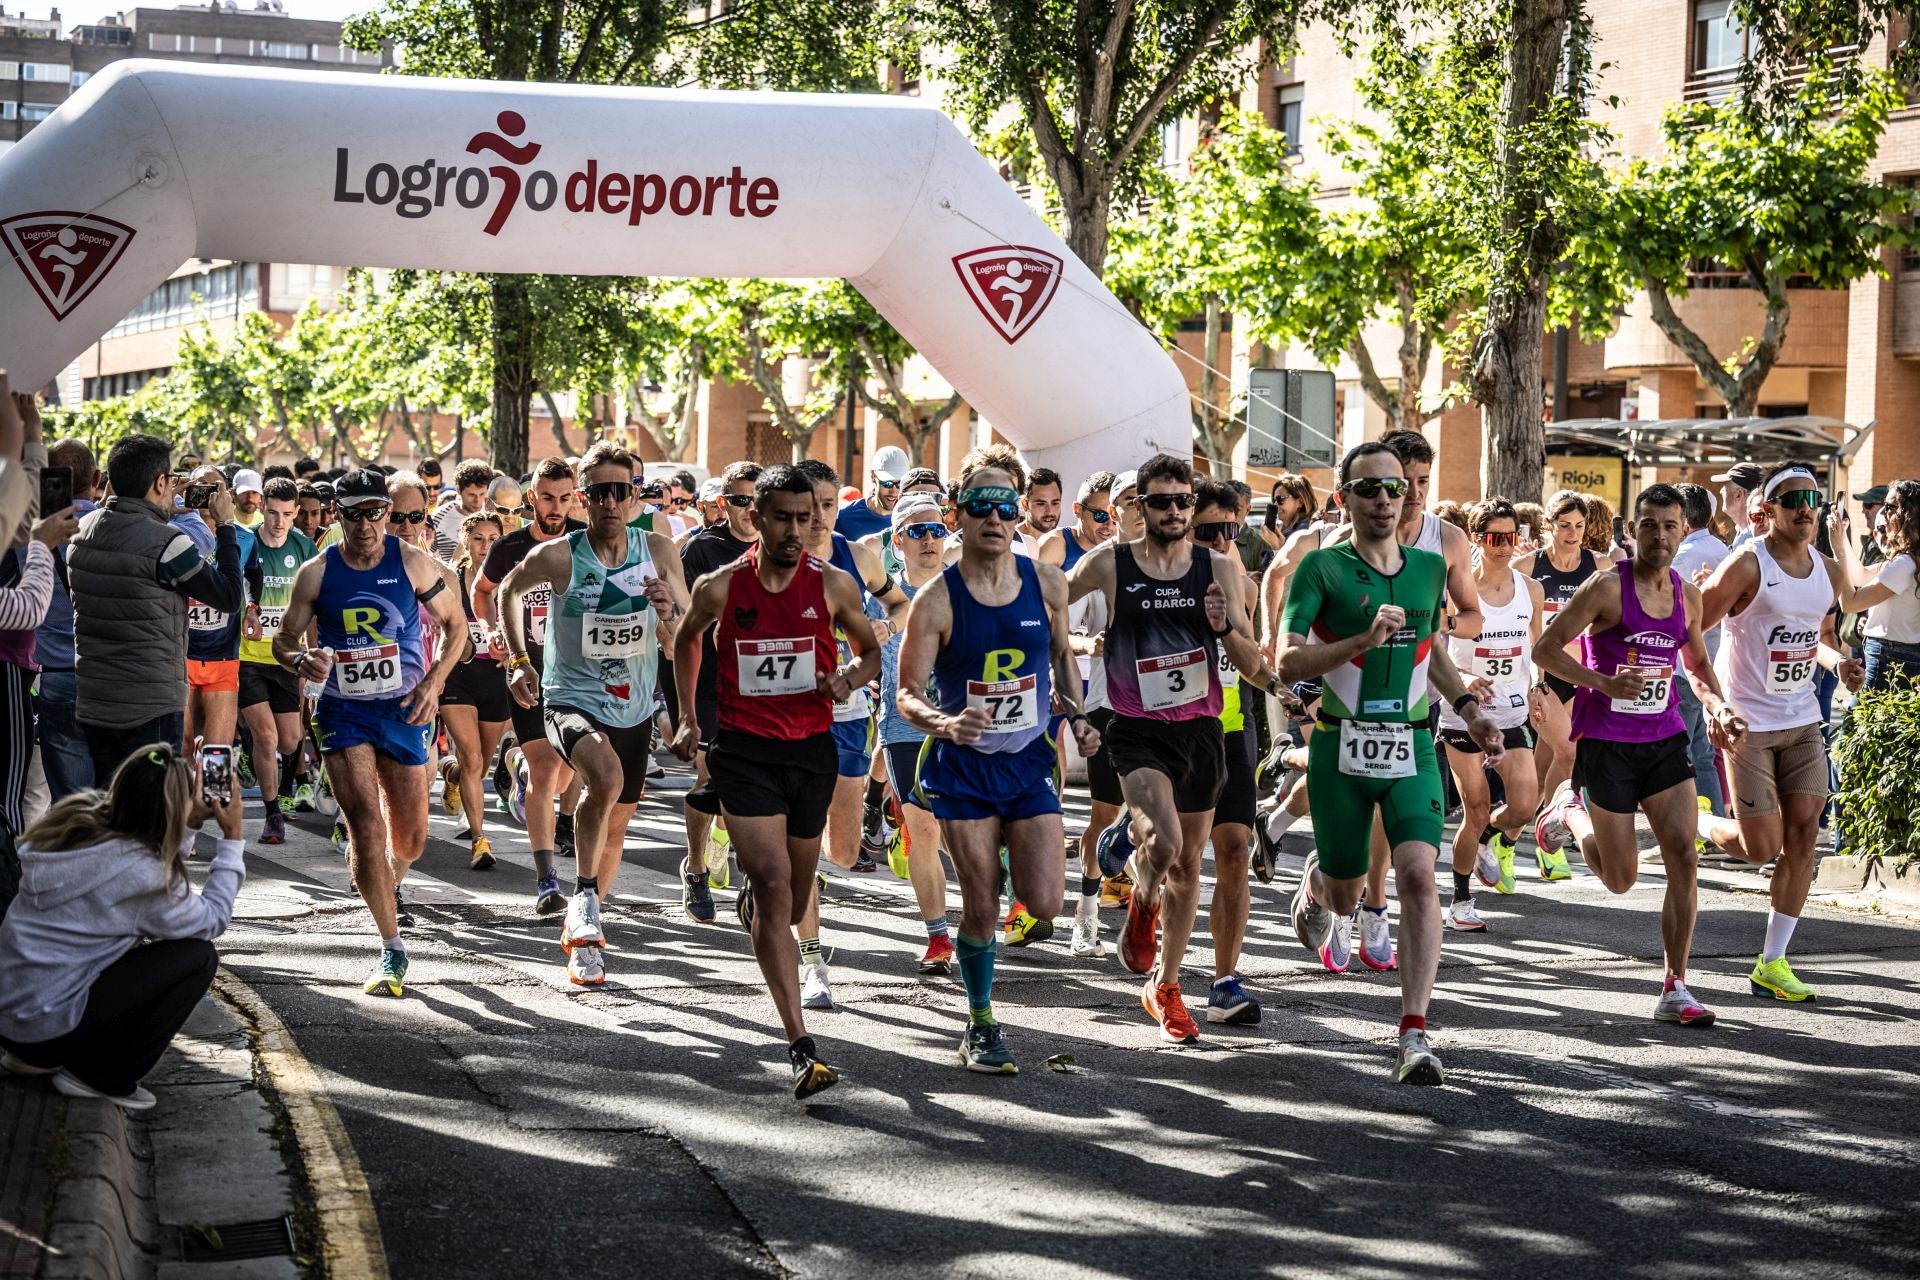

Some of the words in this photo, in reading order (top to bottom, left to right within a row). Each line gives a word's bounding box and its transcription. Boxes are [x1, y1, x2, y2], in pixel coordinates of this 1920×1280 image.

[565, 159, 779, 226] deporte
[78, 232, 111, 247] deporte
[975, 263, 1005, 274] Logroño
[1023, 262, 1049, 274] deporte
[1562, 470, 1605, 488] Rioja
[979, 487, 1011, 499] NIKE
[1155, 588, 1181, 597] CUPA
[1141, 600, 1151, 609] O
[1154, 598, 1196, 609] BARCO
[342, 607, 396, 645] R
[594, 616, 630, 624] CARRERA
[346, 637, 368, 646] CLUB
[587, 625, 643, 646] 1359
[343, 659, 395, 684] 540
[756, 655, 797, 680] 47
[982, 648, 1025, 683] R
[1485, 658, 1513, 677] 35
[1774, 660, 1812, 683] 565
[1167, 669, 1186, 693] 3
[985, 695, 1023, 719] 72
[992, 717, 1018, 725] RUBÉN
[1354, 725, 1395, 733] CARRERA
[1346, 738, 1410, 762] 1075
[1364, 762, 1392, 770] SERGIO
